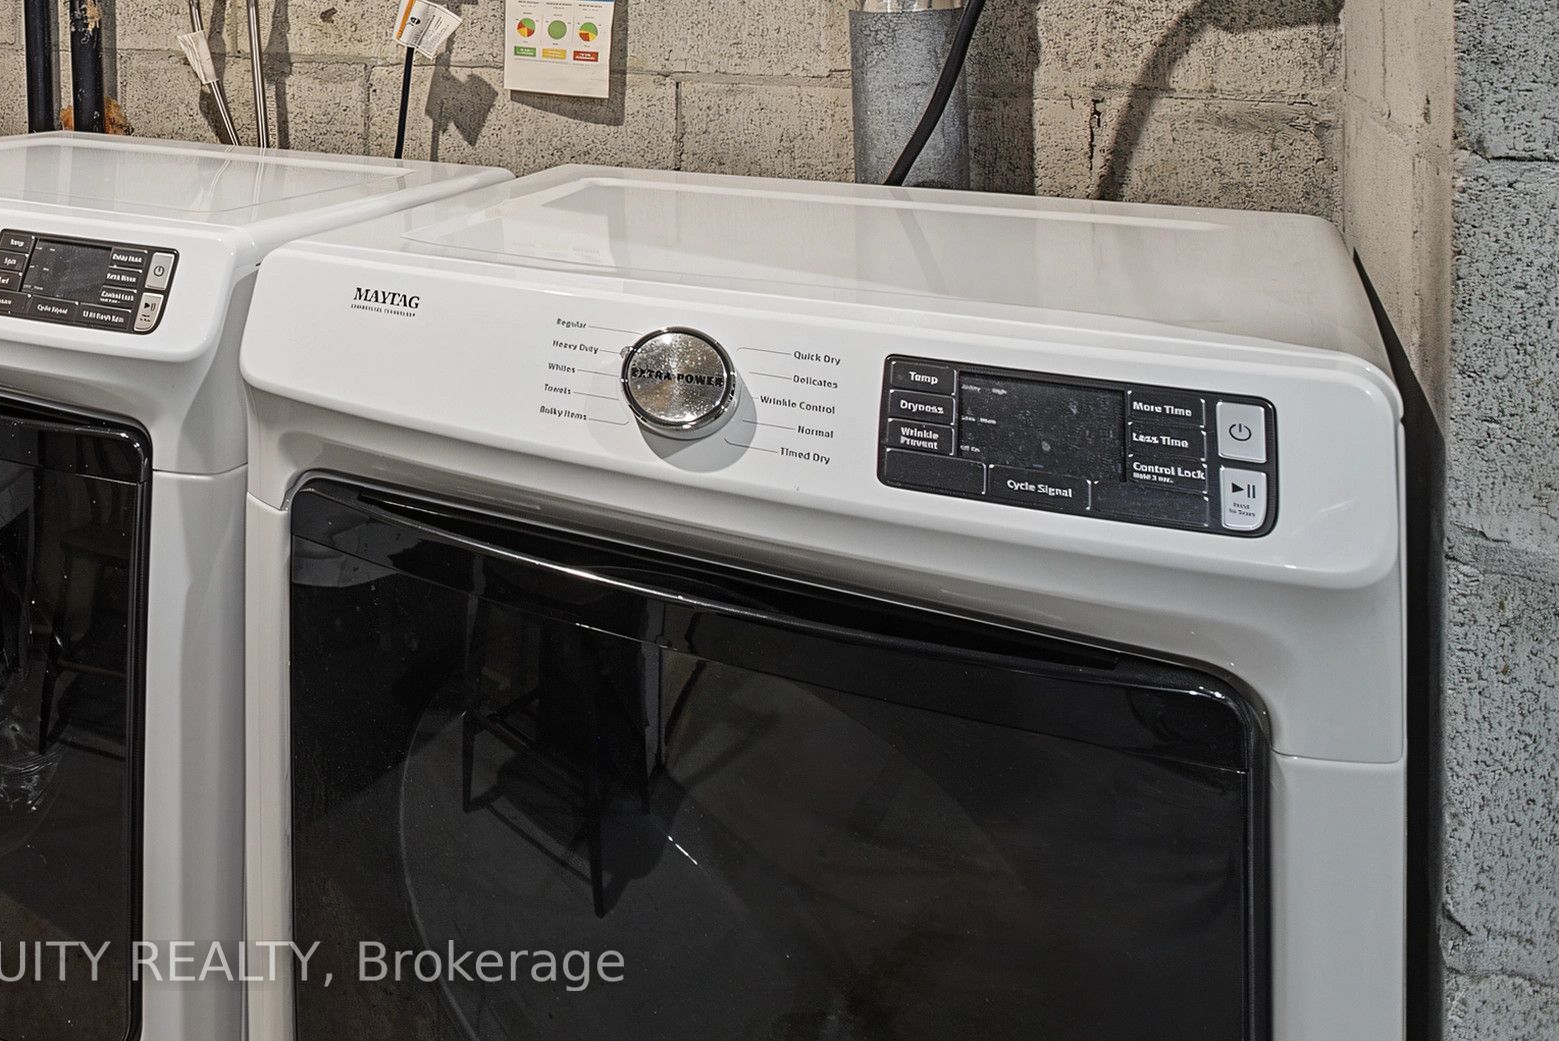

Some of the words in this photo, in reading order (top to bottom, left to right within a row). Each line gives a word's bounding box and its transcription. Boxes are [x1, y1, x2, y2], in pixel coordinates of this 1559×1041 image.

[352, 287, 420, 309] MAYTAG
[556, 317, 587, 329] Regular
[552, 340, 577, 351] Heavy
[579, 343, 599, 355] Duty
[793, 350, 821, 362] Quick
[823, 355, 841, 366] Dry
[548, 362, 576, 374] Whites
[630, 367, 672, 381] EXTRA
[677, 374, 725, 388] POWER
[793, 374, 838, 389] Delicates
[908, 371, 938, 385] Temp
[544, 383, 571, 395] Towels
[760, 395, 797, 409] Wrinkle
[799, 401, 835, 415] Control
[900, 399, 944, 414] Dryness
[1133, 401, 1162, 412] More
[1164, 405, 1192, 417] Time
[540, 405, 563, 418] Bulky
[564, 409, 587, 421] Items
[798, 425, 834, 439] Normal
[901, 426, 939, 440] Wrinkle
[900, 436, 938, 450] Prevent
[1132, 432, 1159, 444] Less
[1160, 436, 1189, 448] Time
[780, 446, 811, 461] Timed
[813, 453, 830, 466] Dry
[1133, 461, 1175, 476] Control
[1177, 467, 1206, 480] Lock
[1006, 479, 1036, 493] Cycle
[1037, 483, 1073, 498] Signal
